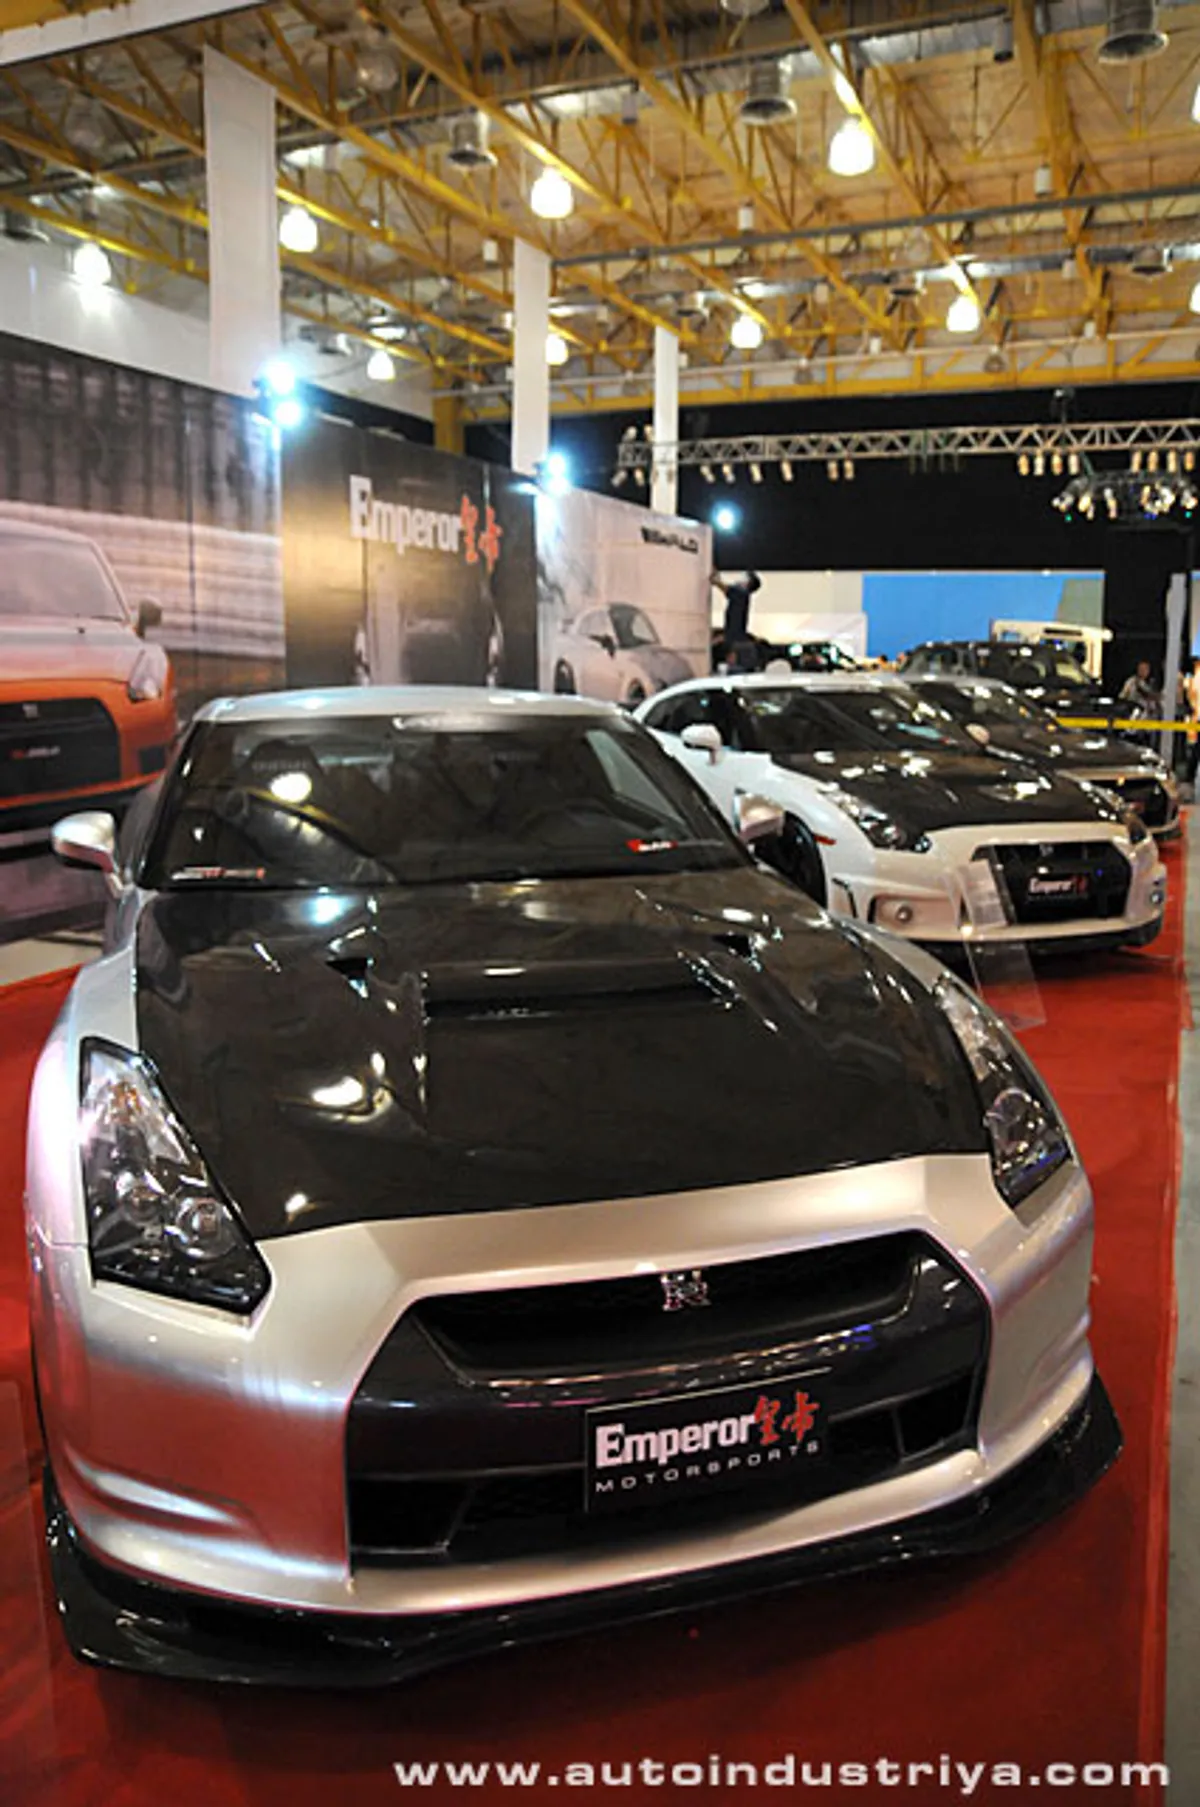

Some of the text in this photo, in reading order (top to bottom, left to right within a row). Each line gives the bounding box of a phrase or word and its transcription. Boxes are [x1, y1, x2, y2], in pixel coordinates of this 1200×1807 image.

[350, 475, 462, 556] Emperor
[595, 1414, 757, 1469] Emperor
[595, 1440, 819, 1493] MOTORSPORTS
